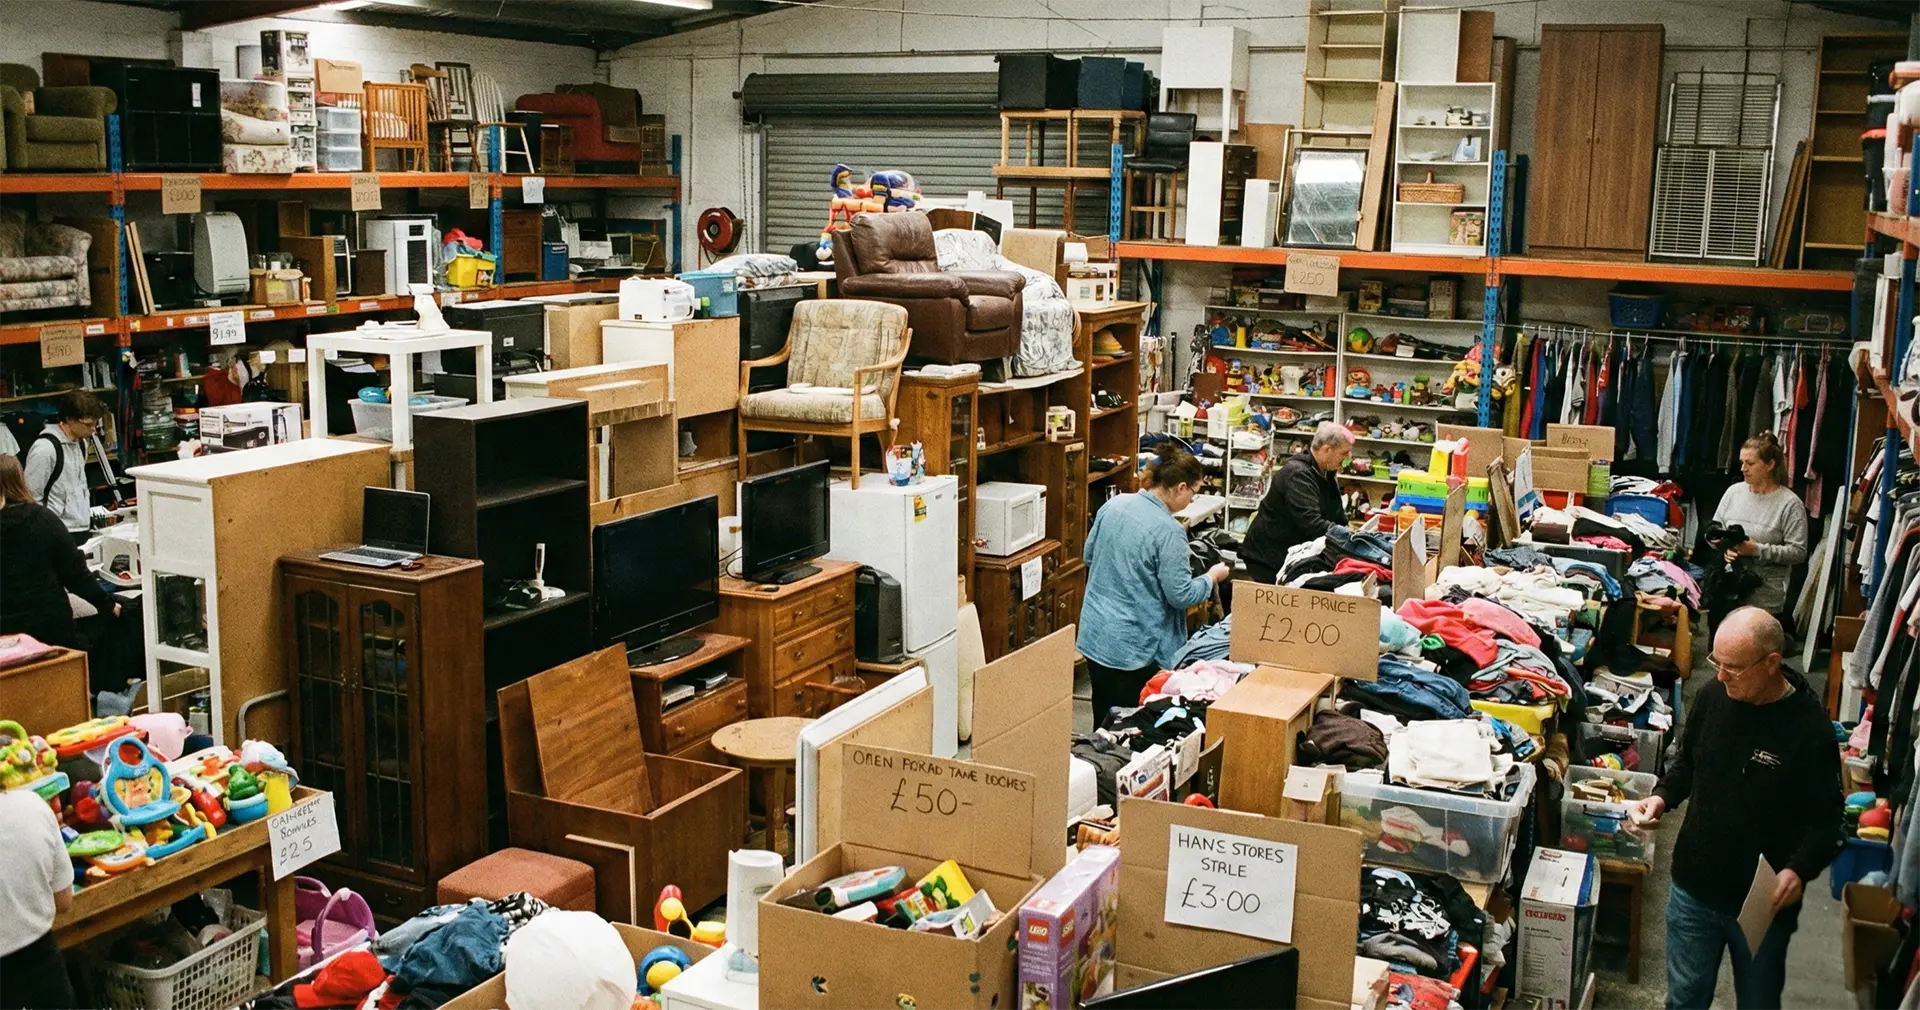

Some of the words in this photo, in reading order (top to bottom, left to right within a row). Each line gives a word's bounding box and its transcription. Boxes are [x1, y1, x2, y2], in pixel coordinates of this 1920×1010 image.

[1255, 588, 1300, 609] PRICE
[1178, 832, 1227, 854] HANS
[1231, 842, 1285, 864] STORES
